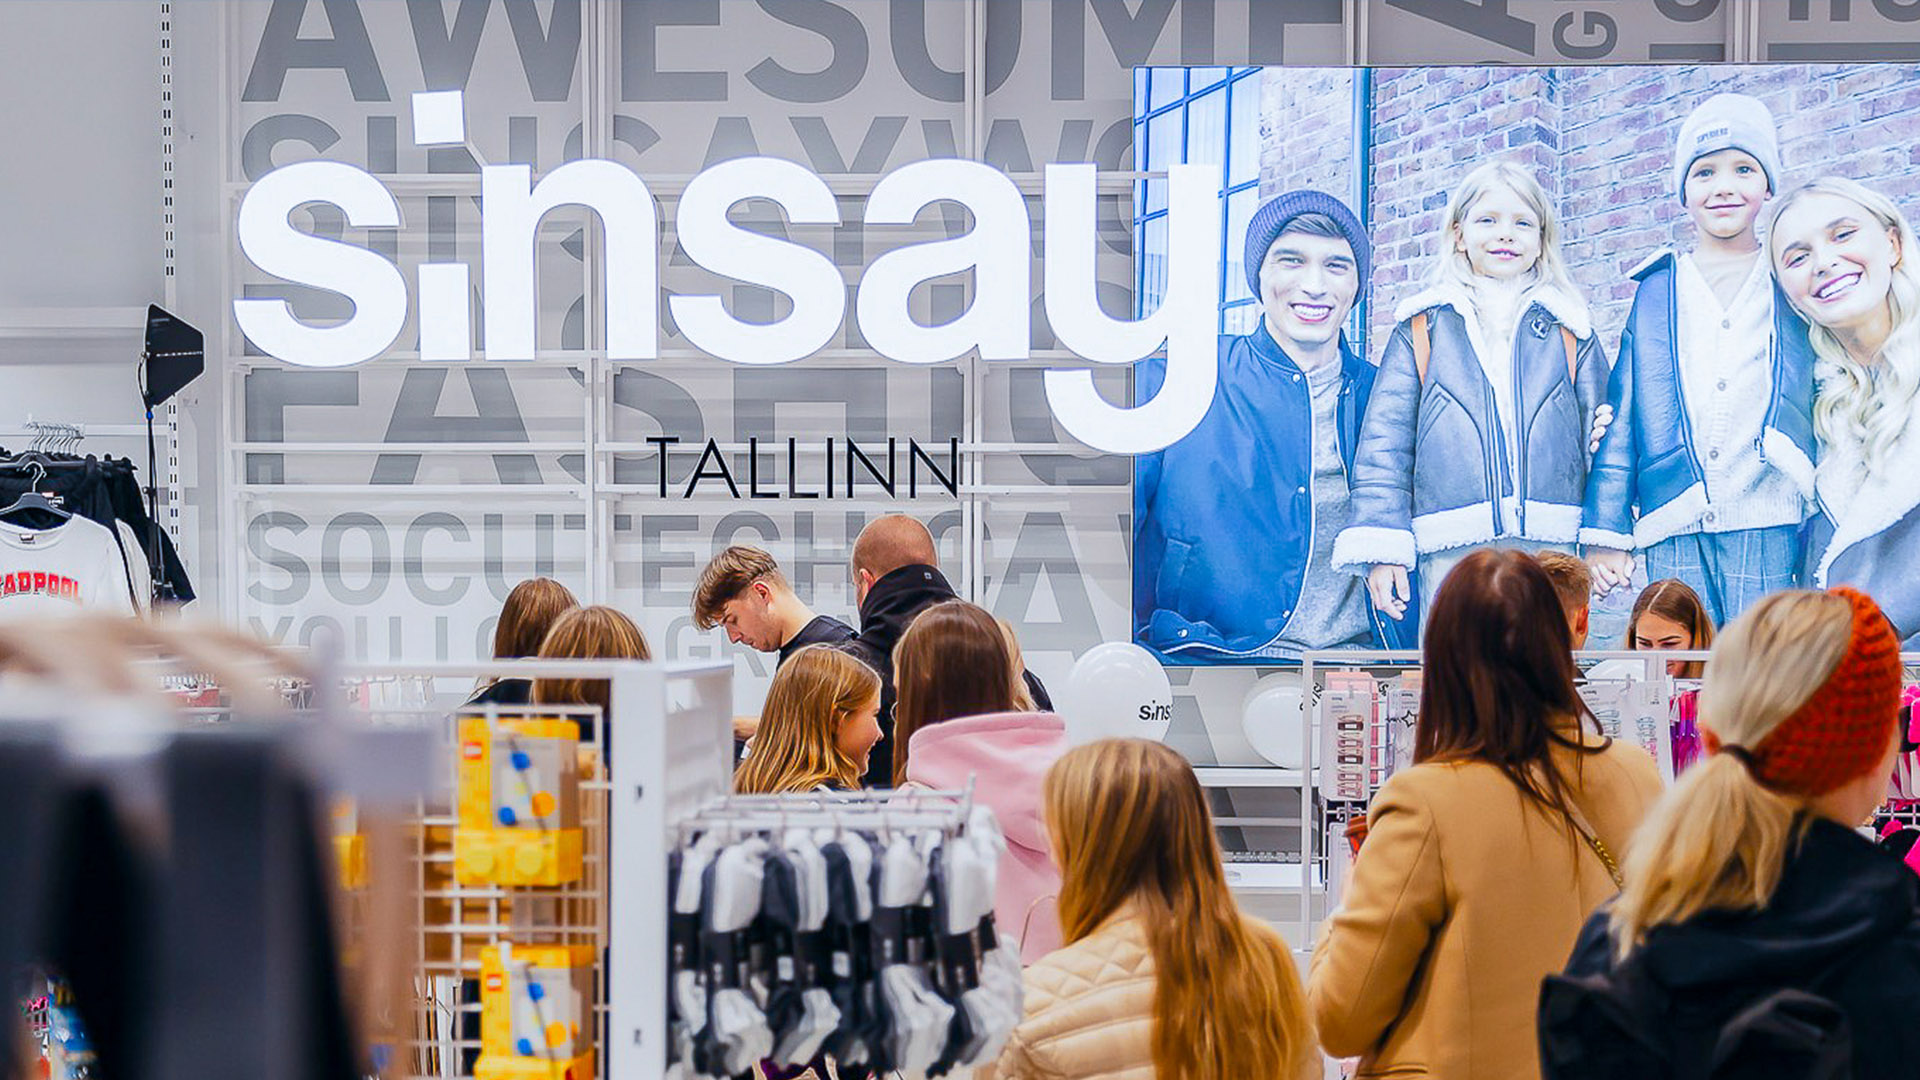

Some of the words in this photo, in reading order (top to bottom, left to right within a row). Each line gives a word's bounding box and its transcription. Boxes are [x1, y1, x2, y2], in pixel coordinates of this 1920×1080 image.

[233, 90, 1219, 454] sinsay
[646, 436, 959, 499] TALLINN
[1138, 699, 1174, 721] sins
